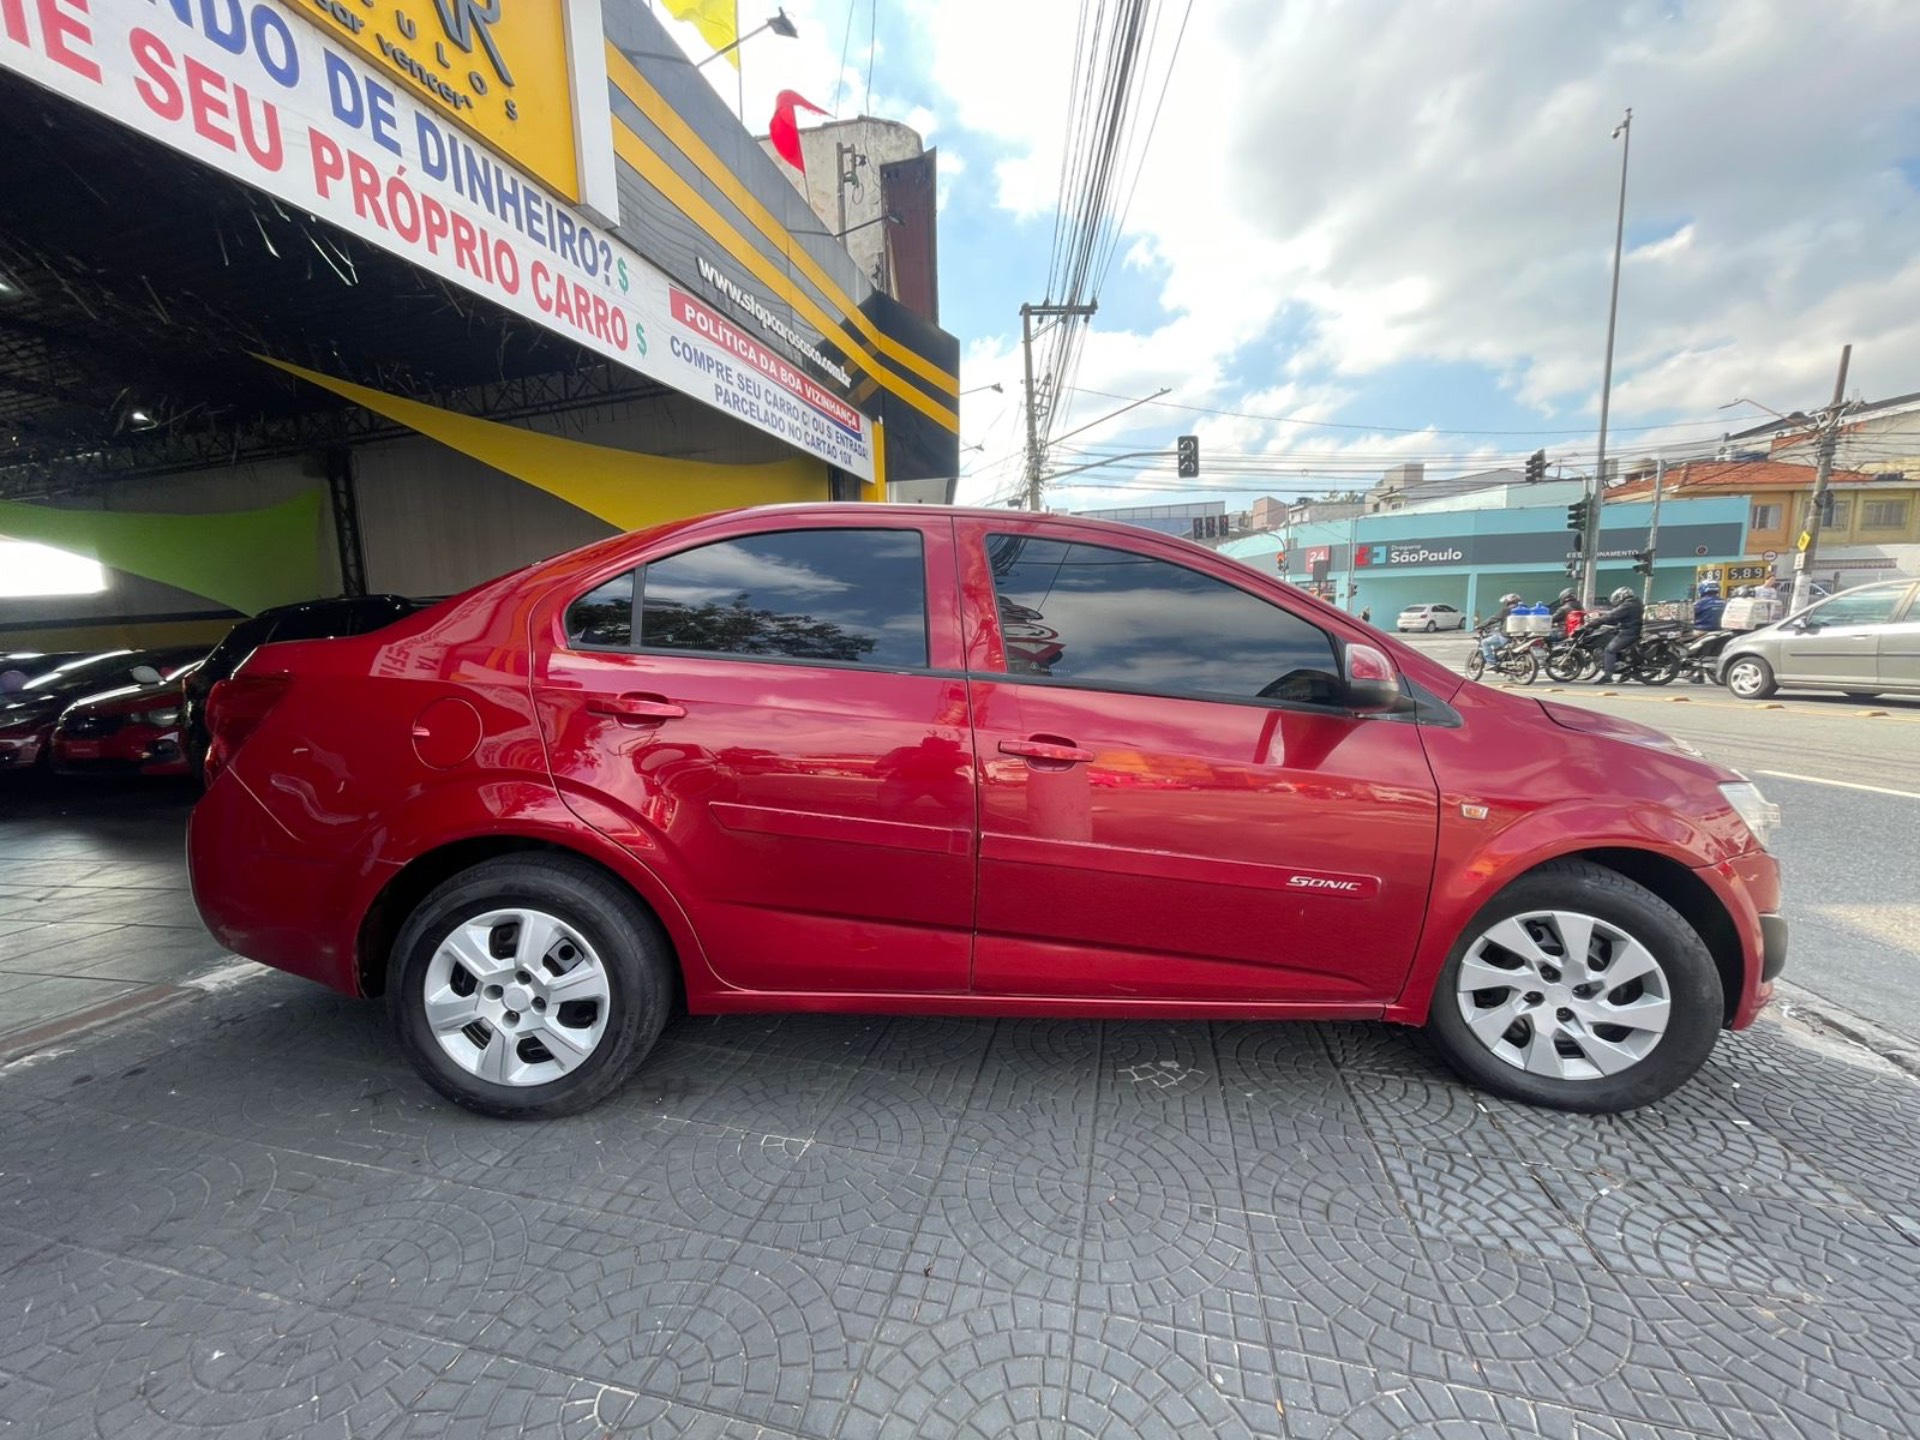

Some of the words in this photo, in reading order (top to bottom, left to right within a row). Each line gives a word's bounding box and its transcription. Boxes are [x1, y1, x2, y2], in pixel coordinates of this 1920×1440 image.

[129, 27, 283, 172] SEU
[308, 126, 520, 296] PRÓPRIO
[530, 260, 629, 351] CARRO
[323, 47, 402, 158] DE
[414, 110, 612, 287] DINHEIRO?
[670, 335, 734, 386] COMPRE
[737, 372, 761, 400] SEU
[764, 388, 799, 421] CARRO
[812, 417, 825, 435] OU
[684, 303, 758, 364] POLÍTICA
[760, 353, 778, 377] DA
[780, 367, 803, 394] BOA
[714, 383, 786, 433] PARCELADO
[787, 421, 802, 442] NO
[1309, 551, 1325, 562] 24
[1286, 876, 1362, 891] SONIC
